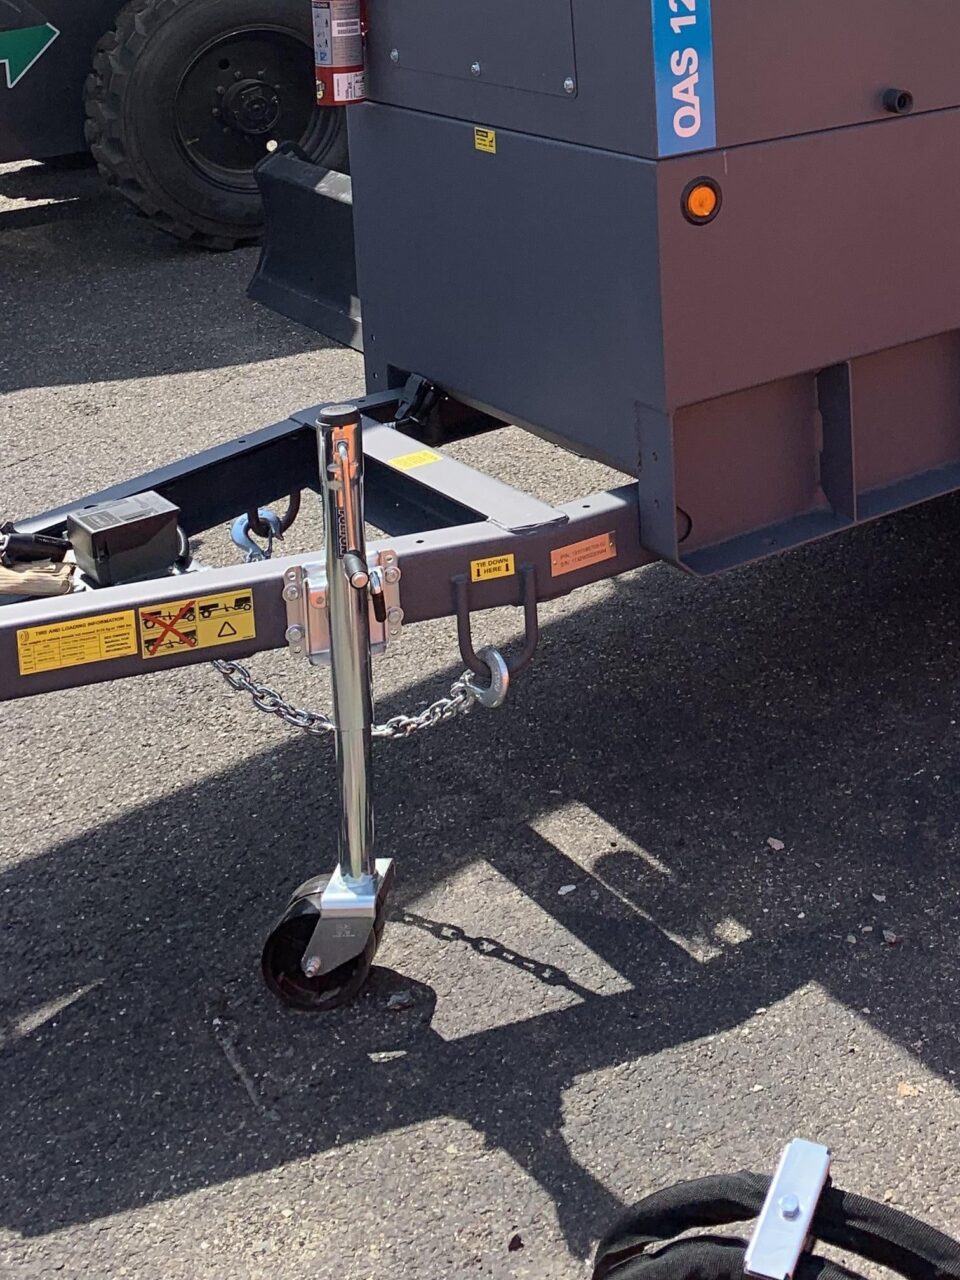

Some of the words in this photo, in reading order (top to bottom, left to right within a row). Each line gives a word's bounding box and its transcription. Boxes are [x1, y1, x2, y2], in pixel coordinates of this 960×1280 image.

[670, 47, 701, 138] QAS
[488, 557, 509, 566] DOWN
[484, 565, 502, 574] HERE
